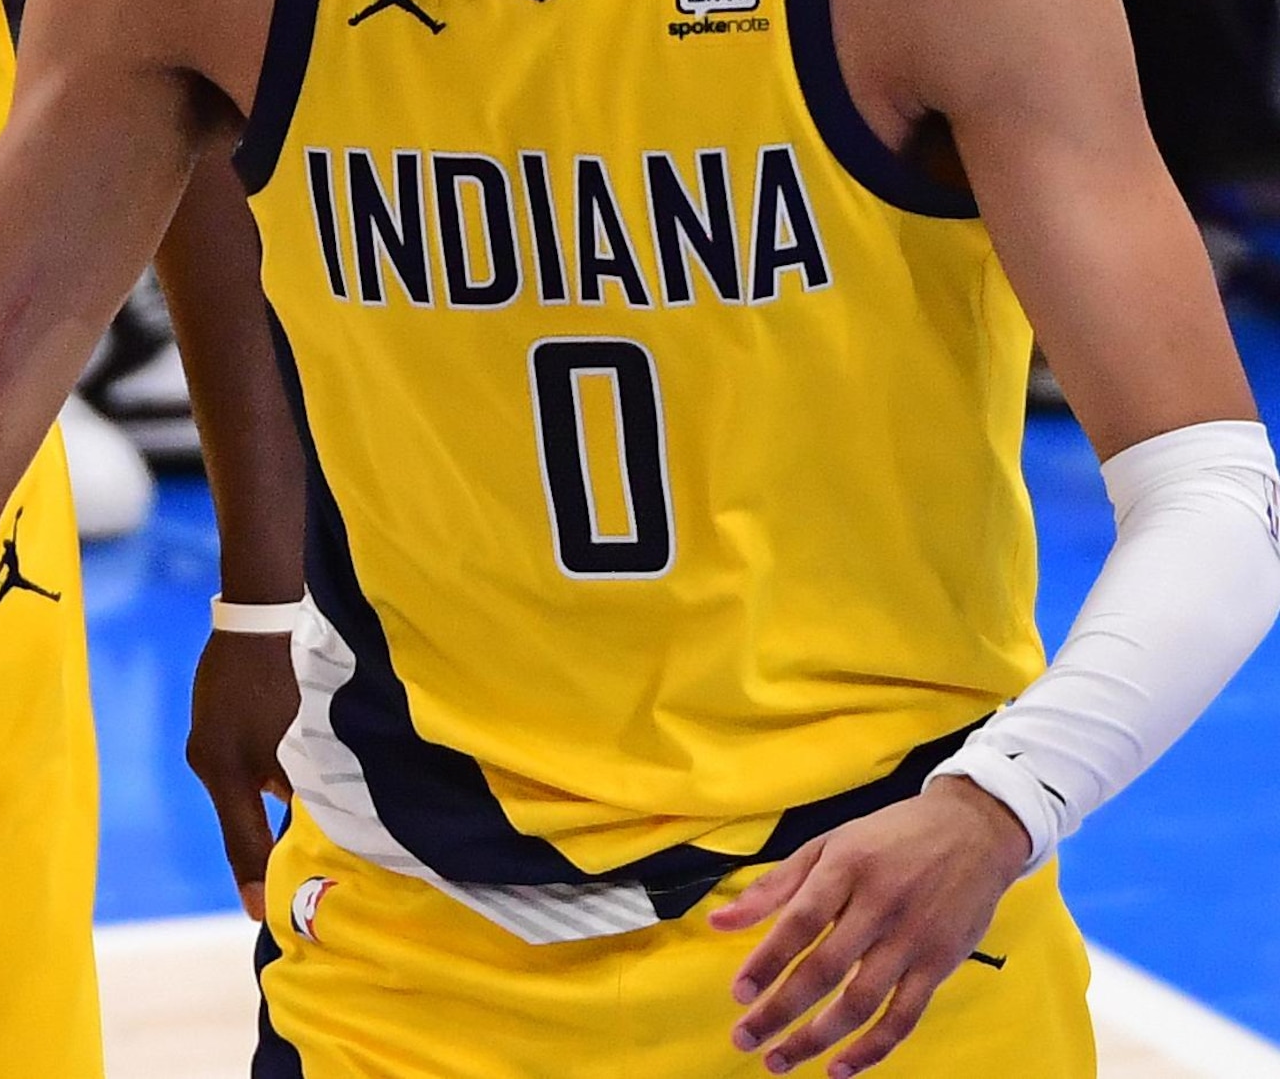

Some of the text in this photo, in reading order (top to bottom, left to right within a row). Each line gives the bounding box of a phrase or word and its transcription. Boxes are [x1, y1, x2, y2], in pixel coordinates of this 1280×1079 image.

[667, 15, 771, 41] spokenote
[304, 142, 834, 309] INDIANA
[527, 335, 677, 581] 0
